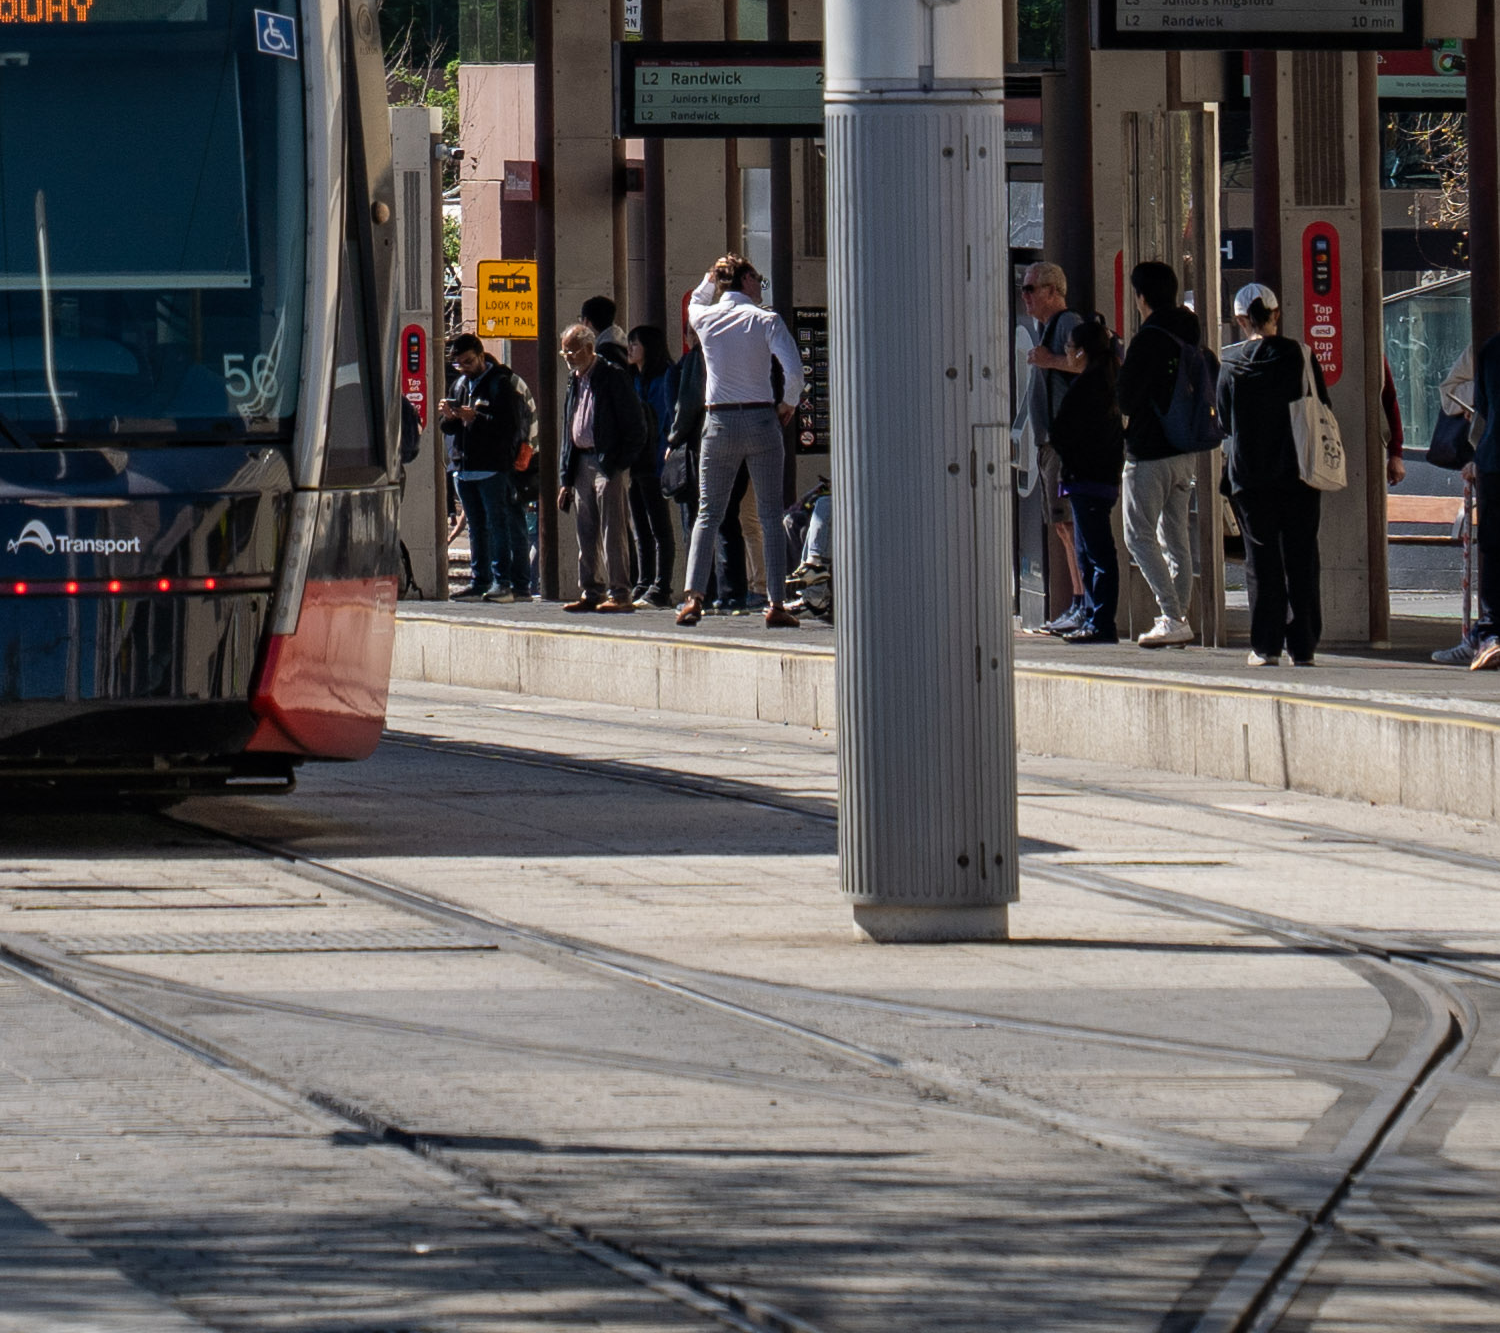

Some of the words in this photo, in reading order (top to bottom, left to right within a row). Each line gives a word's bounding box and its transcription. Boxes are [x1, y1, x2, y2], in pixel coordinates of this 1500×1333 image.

[1125, 15, 1140, 26] L2
[1161, 15, 1223, 27] Randwick
[1351, 16, 1367, 27] 10
[1371, 16, 1394, 27] min
[642, 73, 659, 85] L2
[671, 72, 742, 85] Randwick
[641, 94, 653, 103] L3
[671, 94, 708, 104] Juniors
[711, 94, 760, 105] Kingsford
[641, 111, 653, 120] L2
[671, 111, 720, 121] Randwick
[486, 301, 510, 310] LOOK
[514, 301, 533, 310] FOR
[1313, 304, 1333, 316] Tap
[514, 317, 535, 327] RAIL
[1316, 314, 1330, 322] on
[1314, 340, 1333, 352] tap
[1317, 351, 1332, 362] off
[223, 354, 278, 398] 56
[408, 378, 421, 387] Tap
[56, 536, 140, 555] Transport
